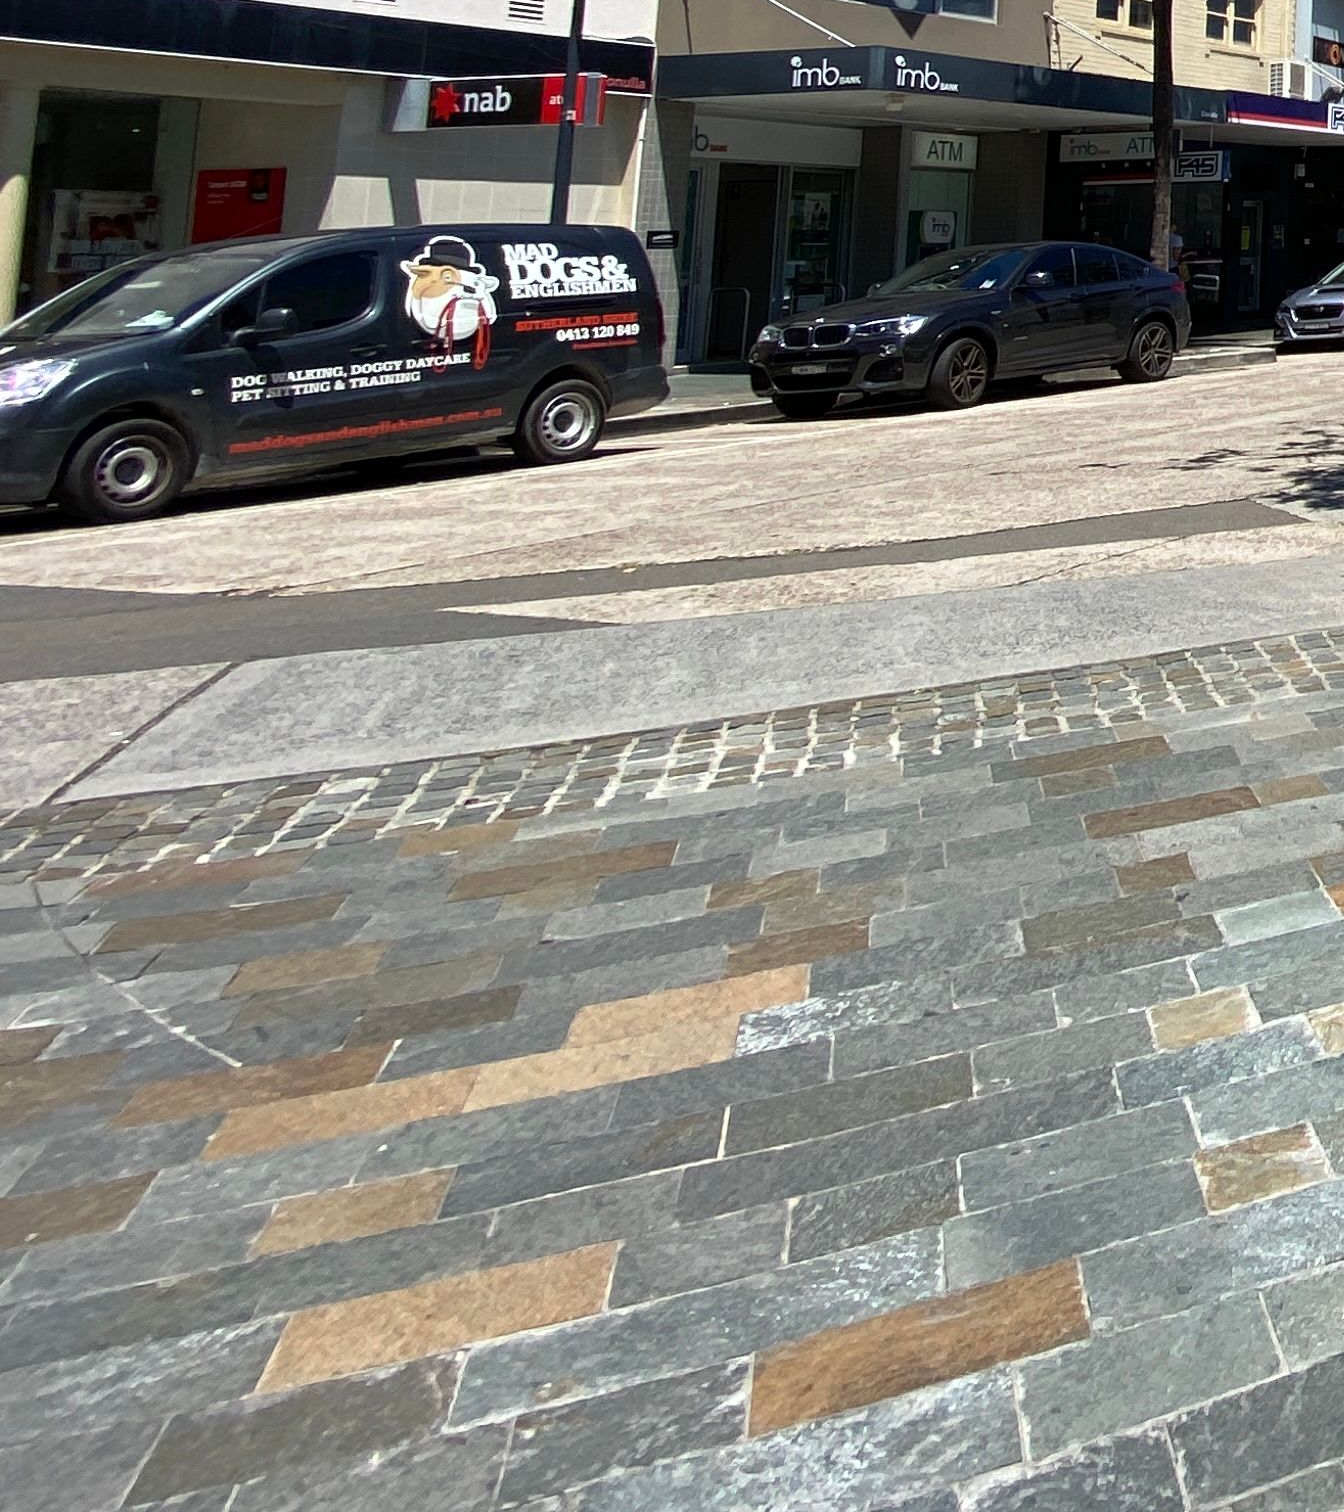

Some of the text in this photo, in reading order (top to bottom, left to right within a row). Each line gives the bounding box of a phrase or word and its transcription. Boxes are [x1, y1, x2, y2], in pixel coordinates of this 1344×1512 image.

[790, 55, 840, 87] imb
[895, 55, 940, 90] imb
[463, 85, 511, 113] nab
[926, 139, 964, 162] ATM
[1174, 153, 1219, 178] F45
[502, 242, 559, 264] MAD
[509, 278, 637, 299] ENGLISHMEN
[556, 323, 640, 342] 0413 120 849
[230, 374, 268, 389] DOG
[350, 360, 403, 376] DOGGY
[405, 352, 471, 370] DAYCARE
[230, 371, 421, 403] PET SITTING & TRAINING
